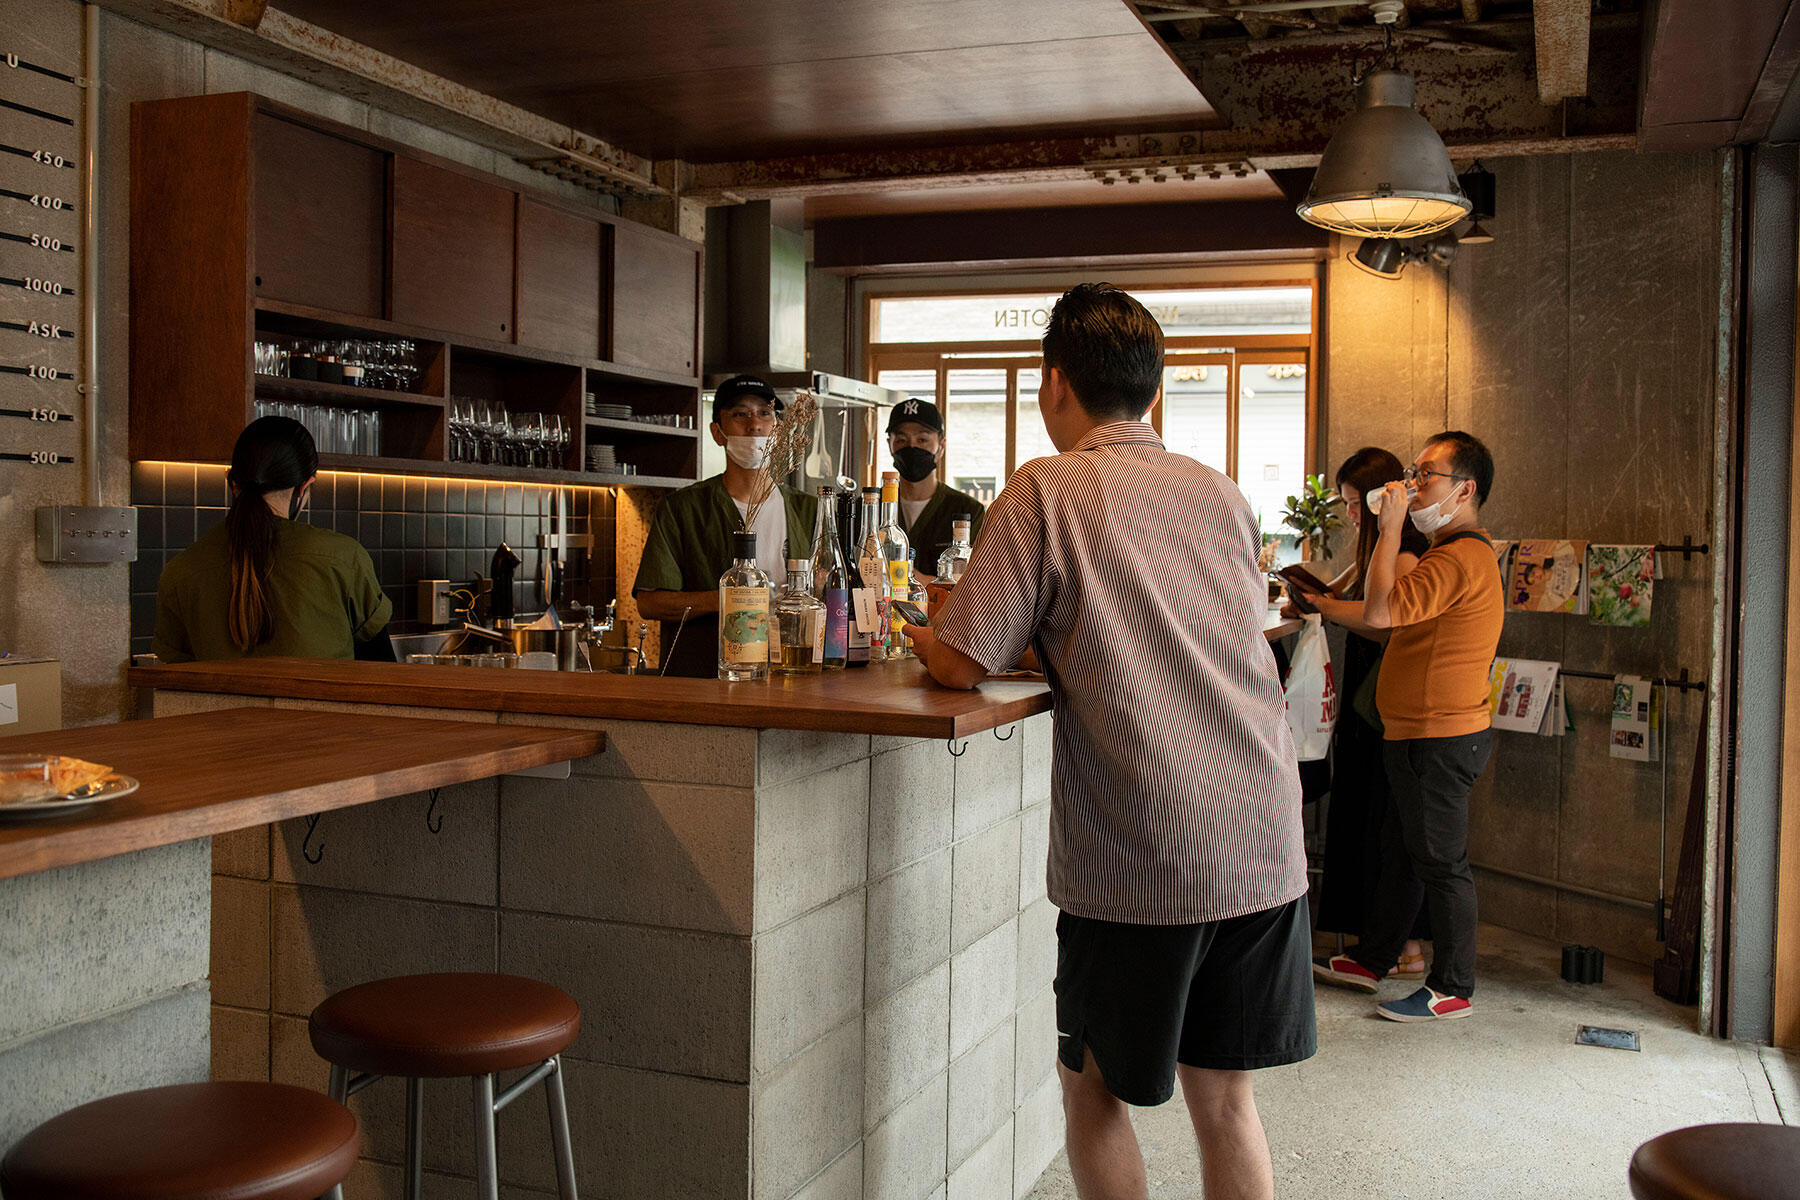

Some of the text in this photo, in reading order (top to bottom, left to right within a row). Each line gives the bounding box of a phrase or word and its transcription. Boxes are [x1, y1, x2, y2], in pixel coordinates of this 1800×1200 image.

[7, 52, 19, 68] U
[32, 149, 64, 168] 450
[30, 194, 62, 210] 400
[30, 234, 61, 252] 500
[24, 277, 62, 296] 1000
[28, 320, 62, 339] ASK
[28, 365, 57, 381] 100
[30, 408, 58, 422] 150
[903, 400, 919, 415] NY
[30, 451, 58, 465] 500
